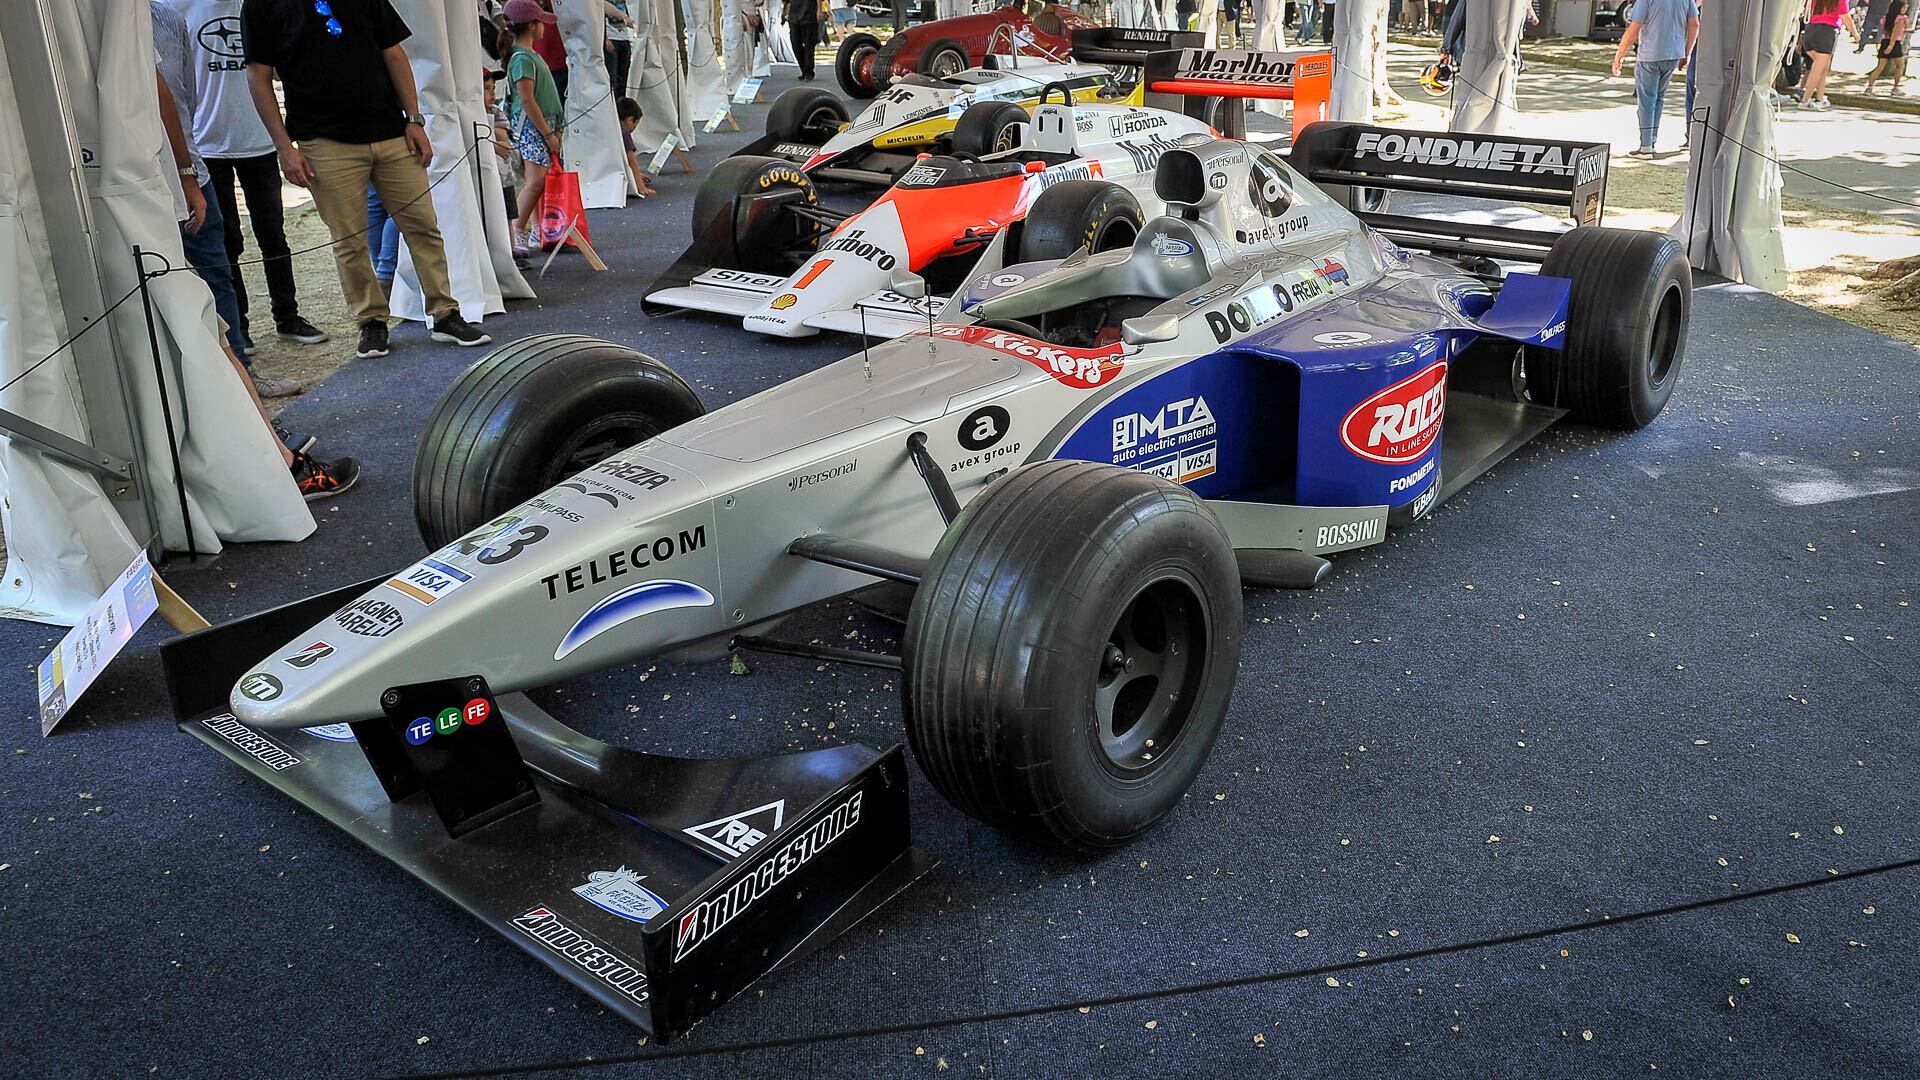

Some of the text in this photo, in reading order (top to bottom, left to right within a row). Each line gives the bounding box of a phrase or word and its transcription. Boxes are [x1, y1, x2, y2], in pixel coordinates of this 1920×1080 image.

[1123, 30, 1169, 42] RENAULT
[1304, 62, 1329, 71] HERCULES
[901, 105, 935, 121] LONGINES
[1076, 120, 1094, 132] BOSS
[1124, 116, 1168, 134] HONDA
[886, 134, 925, 145] MICHELIN
[1278, 214, 1309, 240] group
[711, 270, 784, 288] Shel
[793, 258, 835, 289] 1
[984, 332, 1103, 384] Kickers
[1139, 394, 1216, 440] MTA
[1367, 372, 1447, 448] ROCES
[972, 415, 998, 442] a
[1112, 422, 1217, 464] auto electric material
[950, 442, 1021, 473] avex group
[1185, 452, 1212, 471] VISA
[1386, 445, 1399, 457] IN
[1402, 436, 1422, 453] LINE
[797, 458, 858, 489] Personal
[1389, 456, 1435, 494] FONDMETAL
[602, 484, 636, 501] TELECOM
[1316, 518, 1379, 548] BOSSINI
[540, 524, 707, 601] TELECOM
[407, 567, 452, 593] VISA
[410, 703, 485, 740] TE LE FE
[201, 713, 301, 772] BRIDGESTONE
[717, 818, 769, 853] RE
[674, 790, 863, 964] BRIDGESTONE
